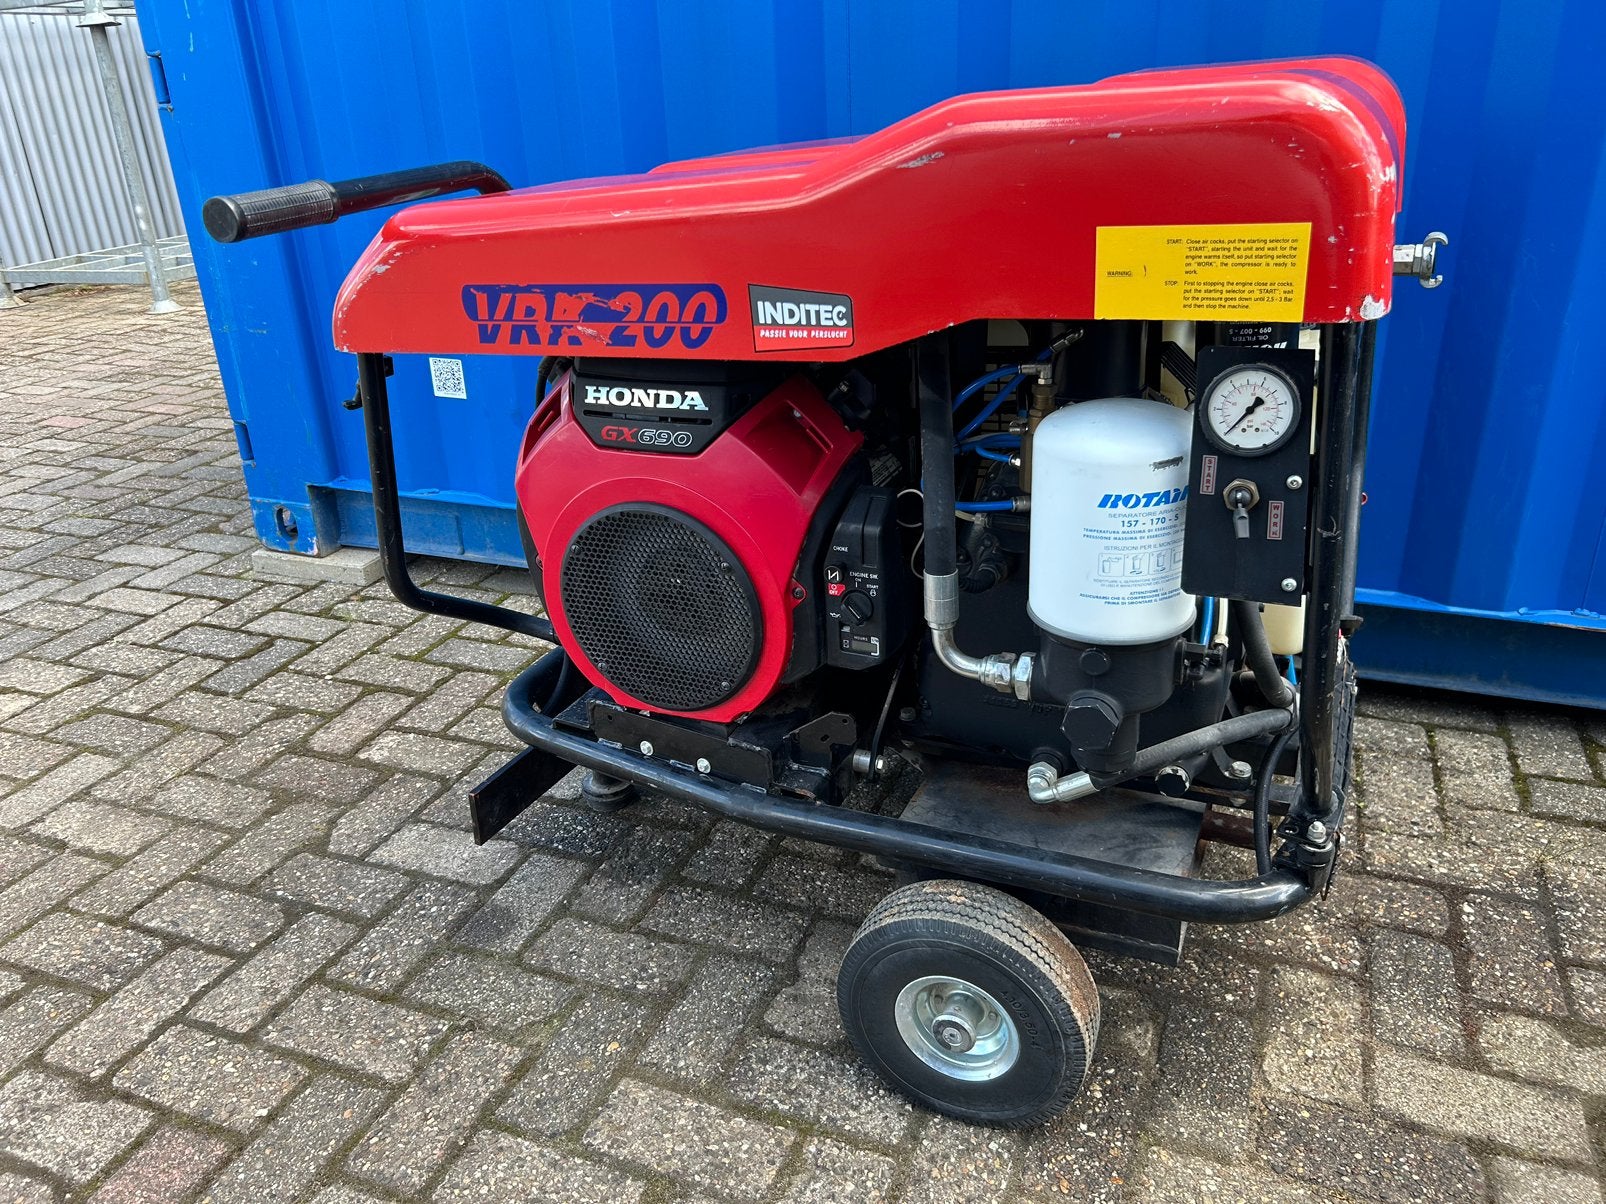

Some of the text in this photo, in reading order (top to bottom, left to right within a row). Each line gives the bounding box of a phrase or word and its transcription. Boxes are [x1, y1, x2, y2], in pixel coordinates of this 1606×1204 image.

[606, 291, 717, 349] 200
[757, 301, 847, 326] INDITEC
[585, 386, 709, 411] HONDA
[601, 425, 692, 448] GX690
[1150, 517, 1166, 526] 170
